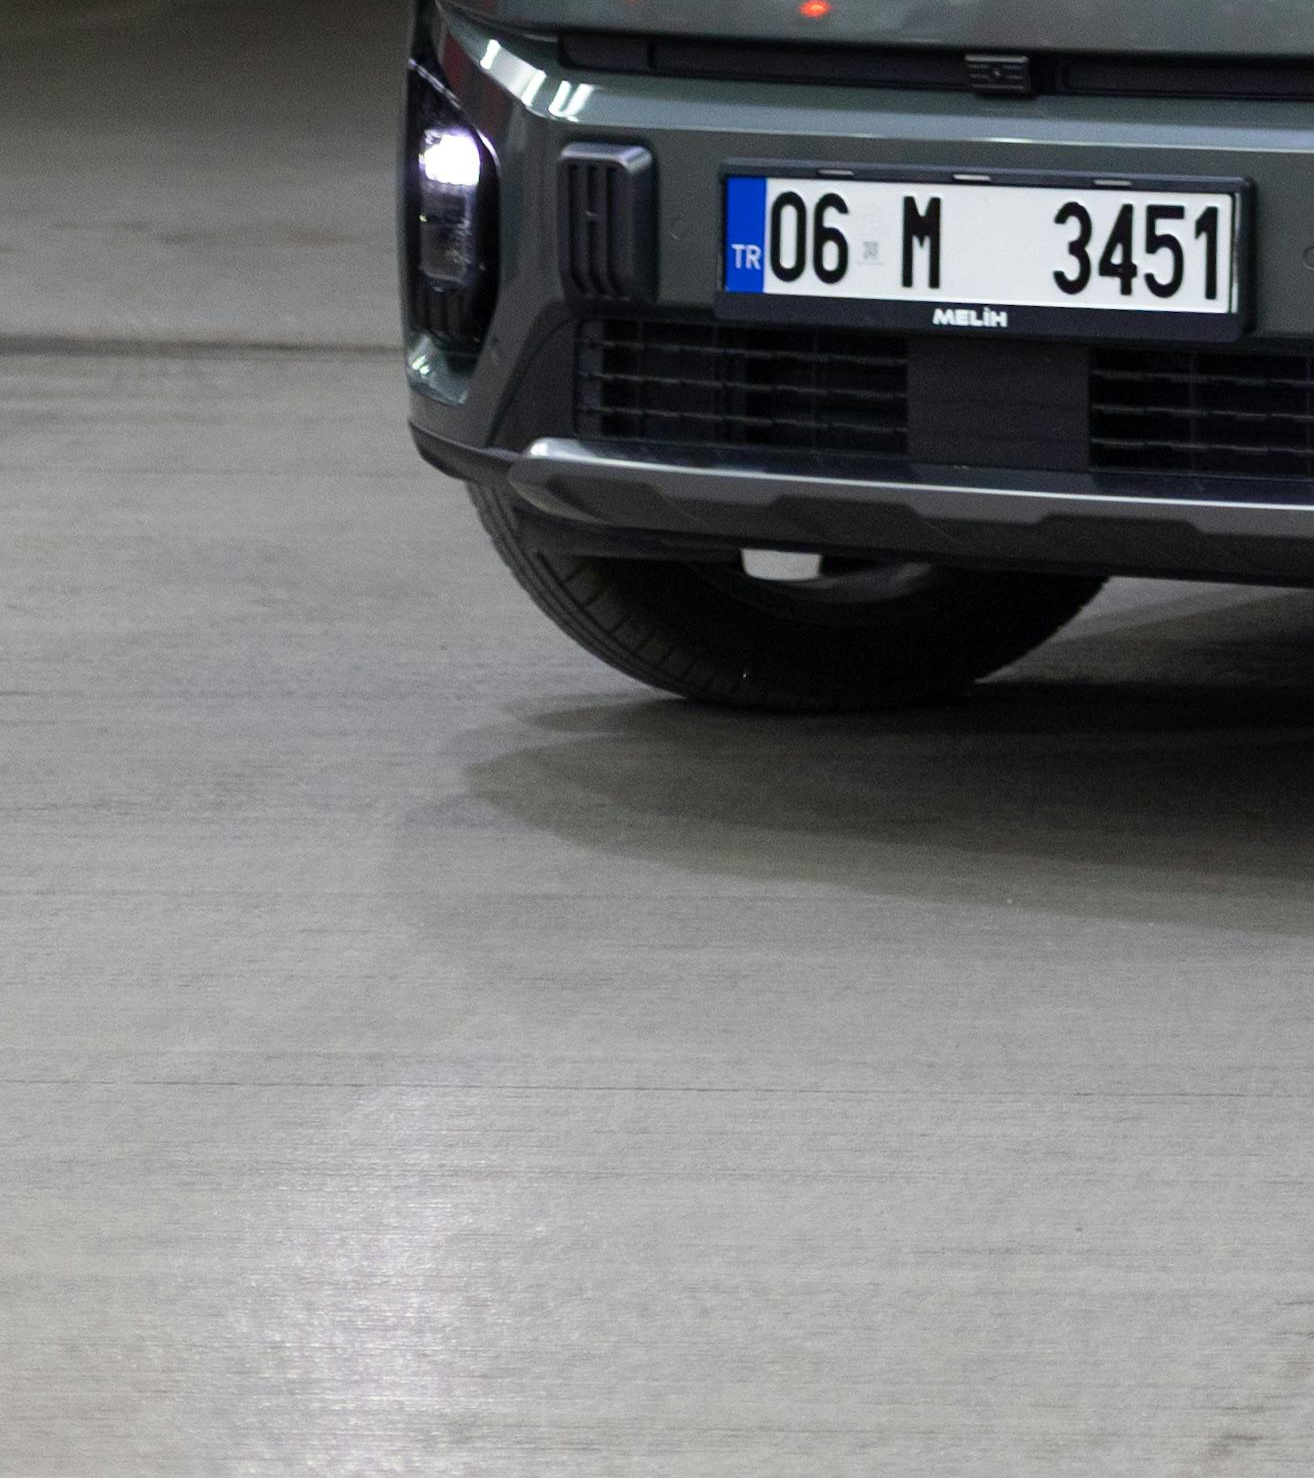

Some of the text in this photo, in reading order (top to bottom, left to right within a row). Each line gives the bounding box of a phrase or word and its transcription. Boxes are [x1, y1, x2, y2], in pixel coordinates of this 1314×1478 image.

[732, 244, 762, 270] TR
[770, 191, 1218, 300] 06 M 3451
